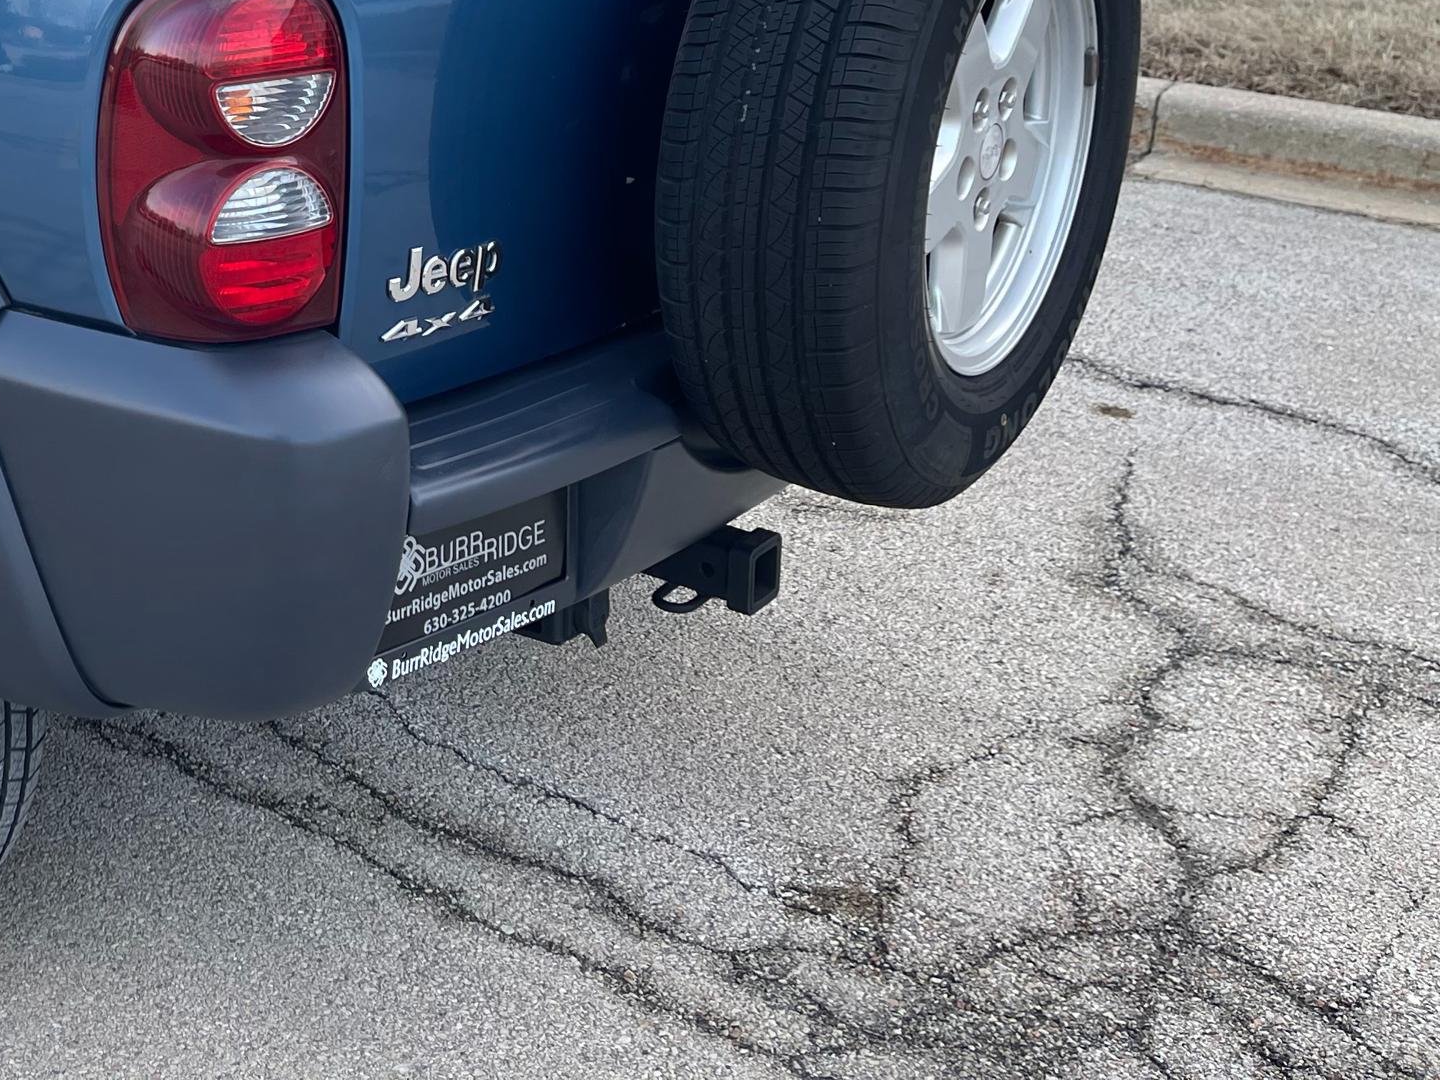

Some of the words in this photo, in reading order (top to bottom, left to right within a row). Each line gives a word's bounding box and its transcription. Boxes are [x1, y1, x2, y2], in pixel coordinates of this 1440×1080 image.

[388, 241, 500, 303] Jeep
[485, 520, 546, 562] RIDGE
[421, 569, 453, 587] MOTOR
[452, 557, 480, 576] SALES
[423, 588, 512, 635] 630-325-4200
[391, 598, 557, 680] BurrRidgeMotorSales.com
